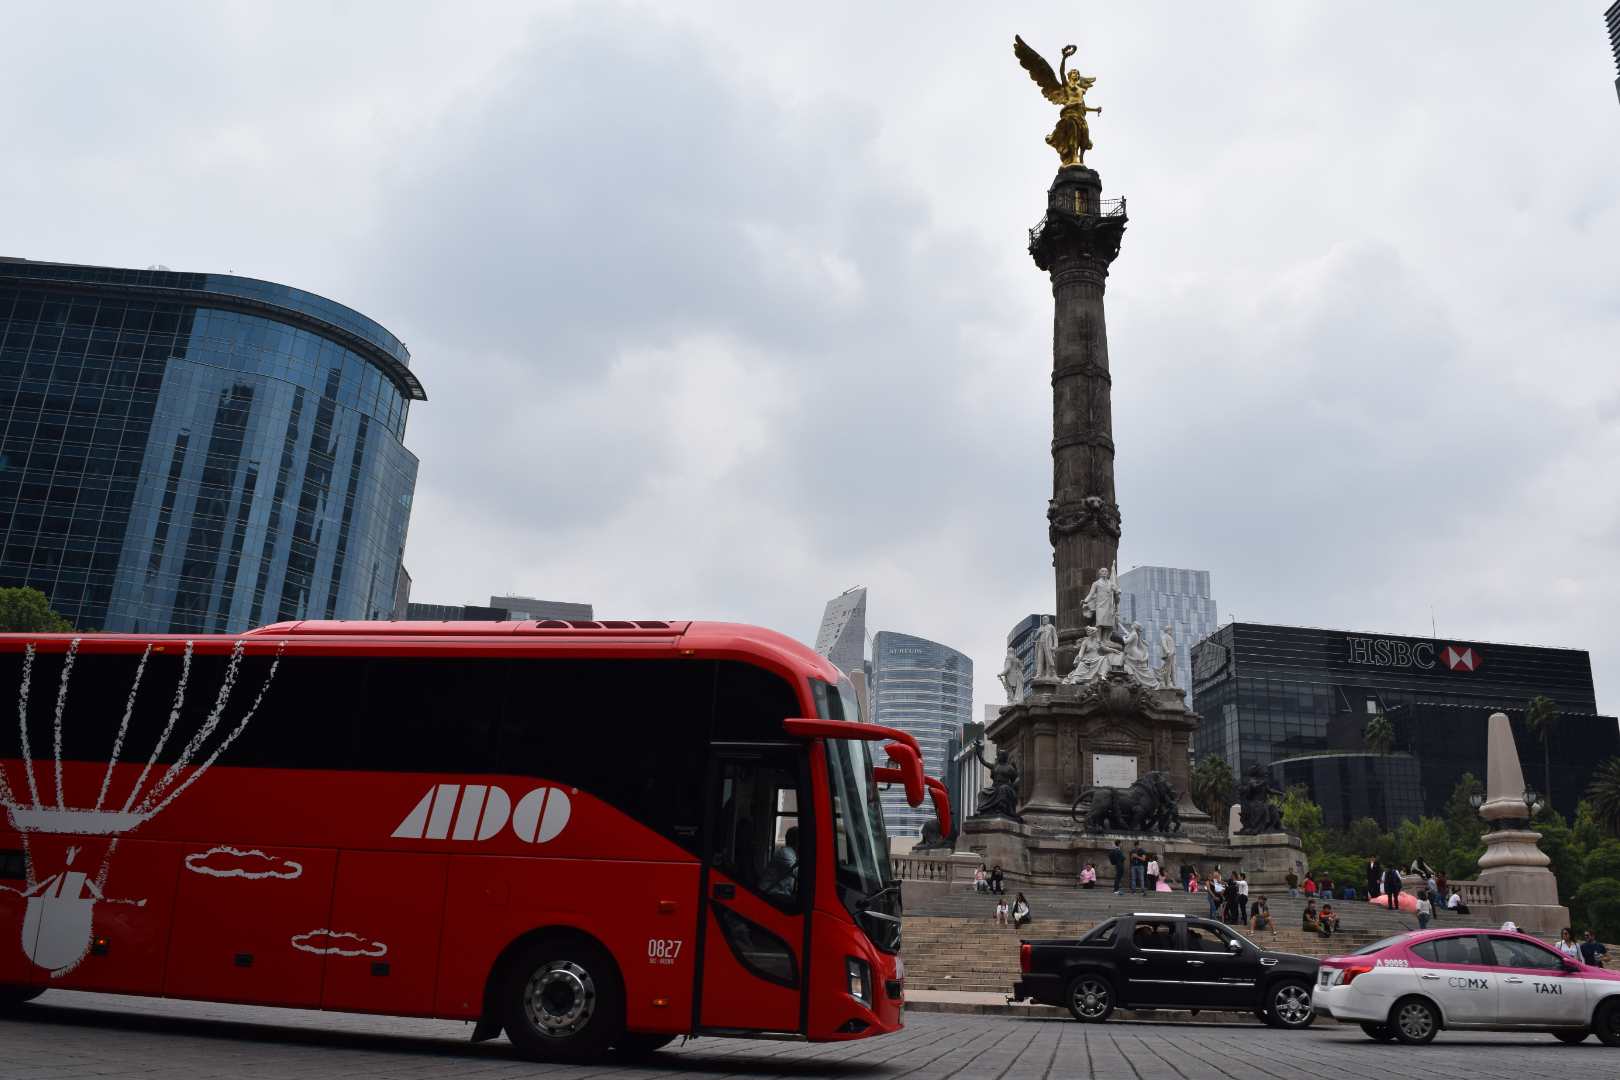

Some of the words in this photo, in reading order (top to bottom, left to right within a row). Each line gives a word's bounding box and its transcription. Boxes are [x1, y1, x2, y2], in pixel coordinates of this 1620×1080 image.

[1346, 635, 1436, 669] HSBC
[390, 784, 571, 844] ADO
[648, 939, 682, 958] 0827
[1448, 976, 1489, 990] CDMX
[1533, 982, 1563, 995] TAXI
